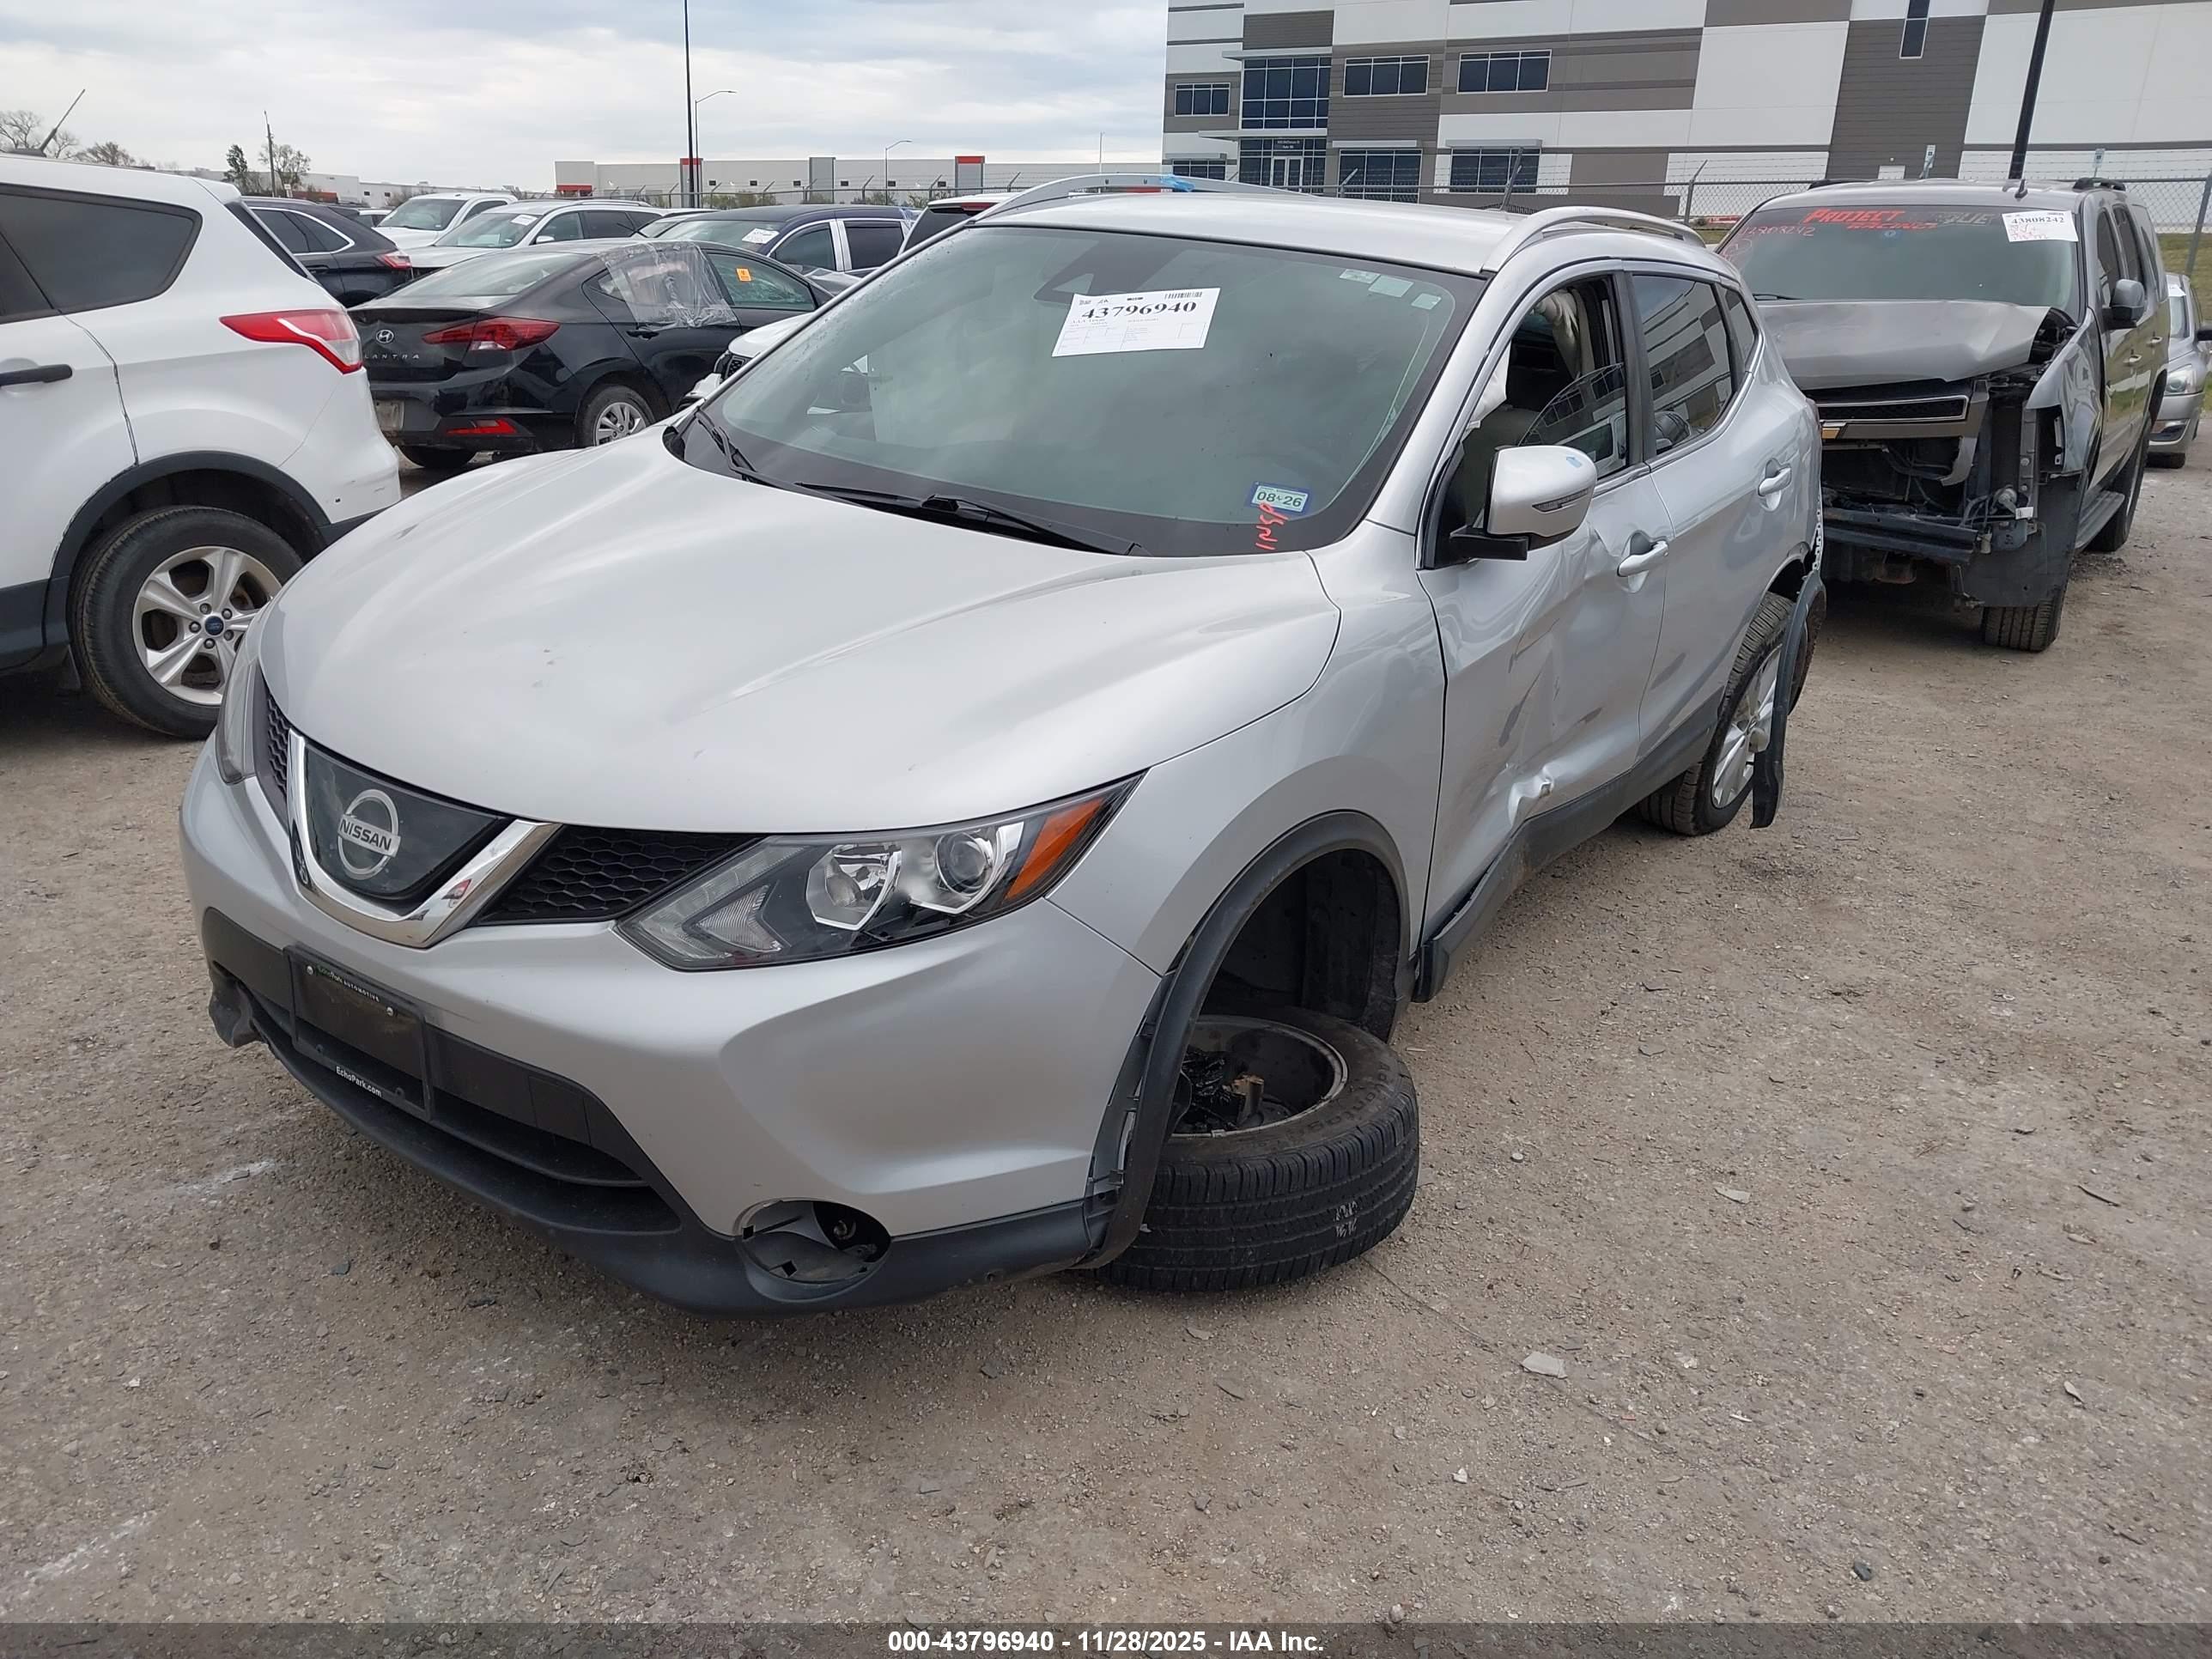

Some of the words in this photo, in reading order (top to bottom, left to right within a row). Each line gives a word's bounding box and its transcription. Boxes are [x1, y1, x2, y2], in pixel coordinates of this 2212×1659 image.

[1802, 209, 1906, 223] PROJECT
[2011, 216, 2065, 225] 43808242
[1081, 301, 1197, 319] 43796940
[1257, 491, 1276, 502] 08
[1283, 495, 1303, 507] 26
[339, 819, 392, 852] NISSAN
[336, 1066, 382, 1097] EchoPark.com
